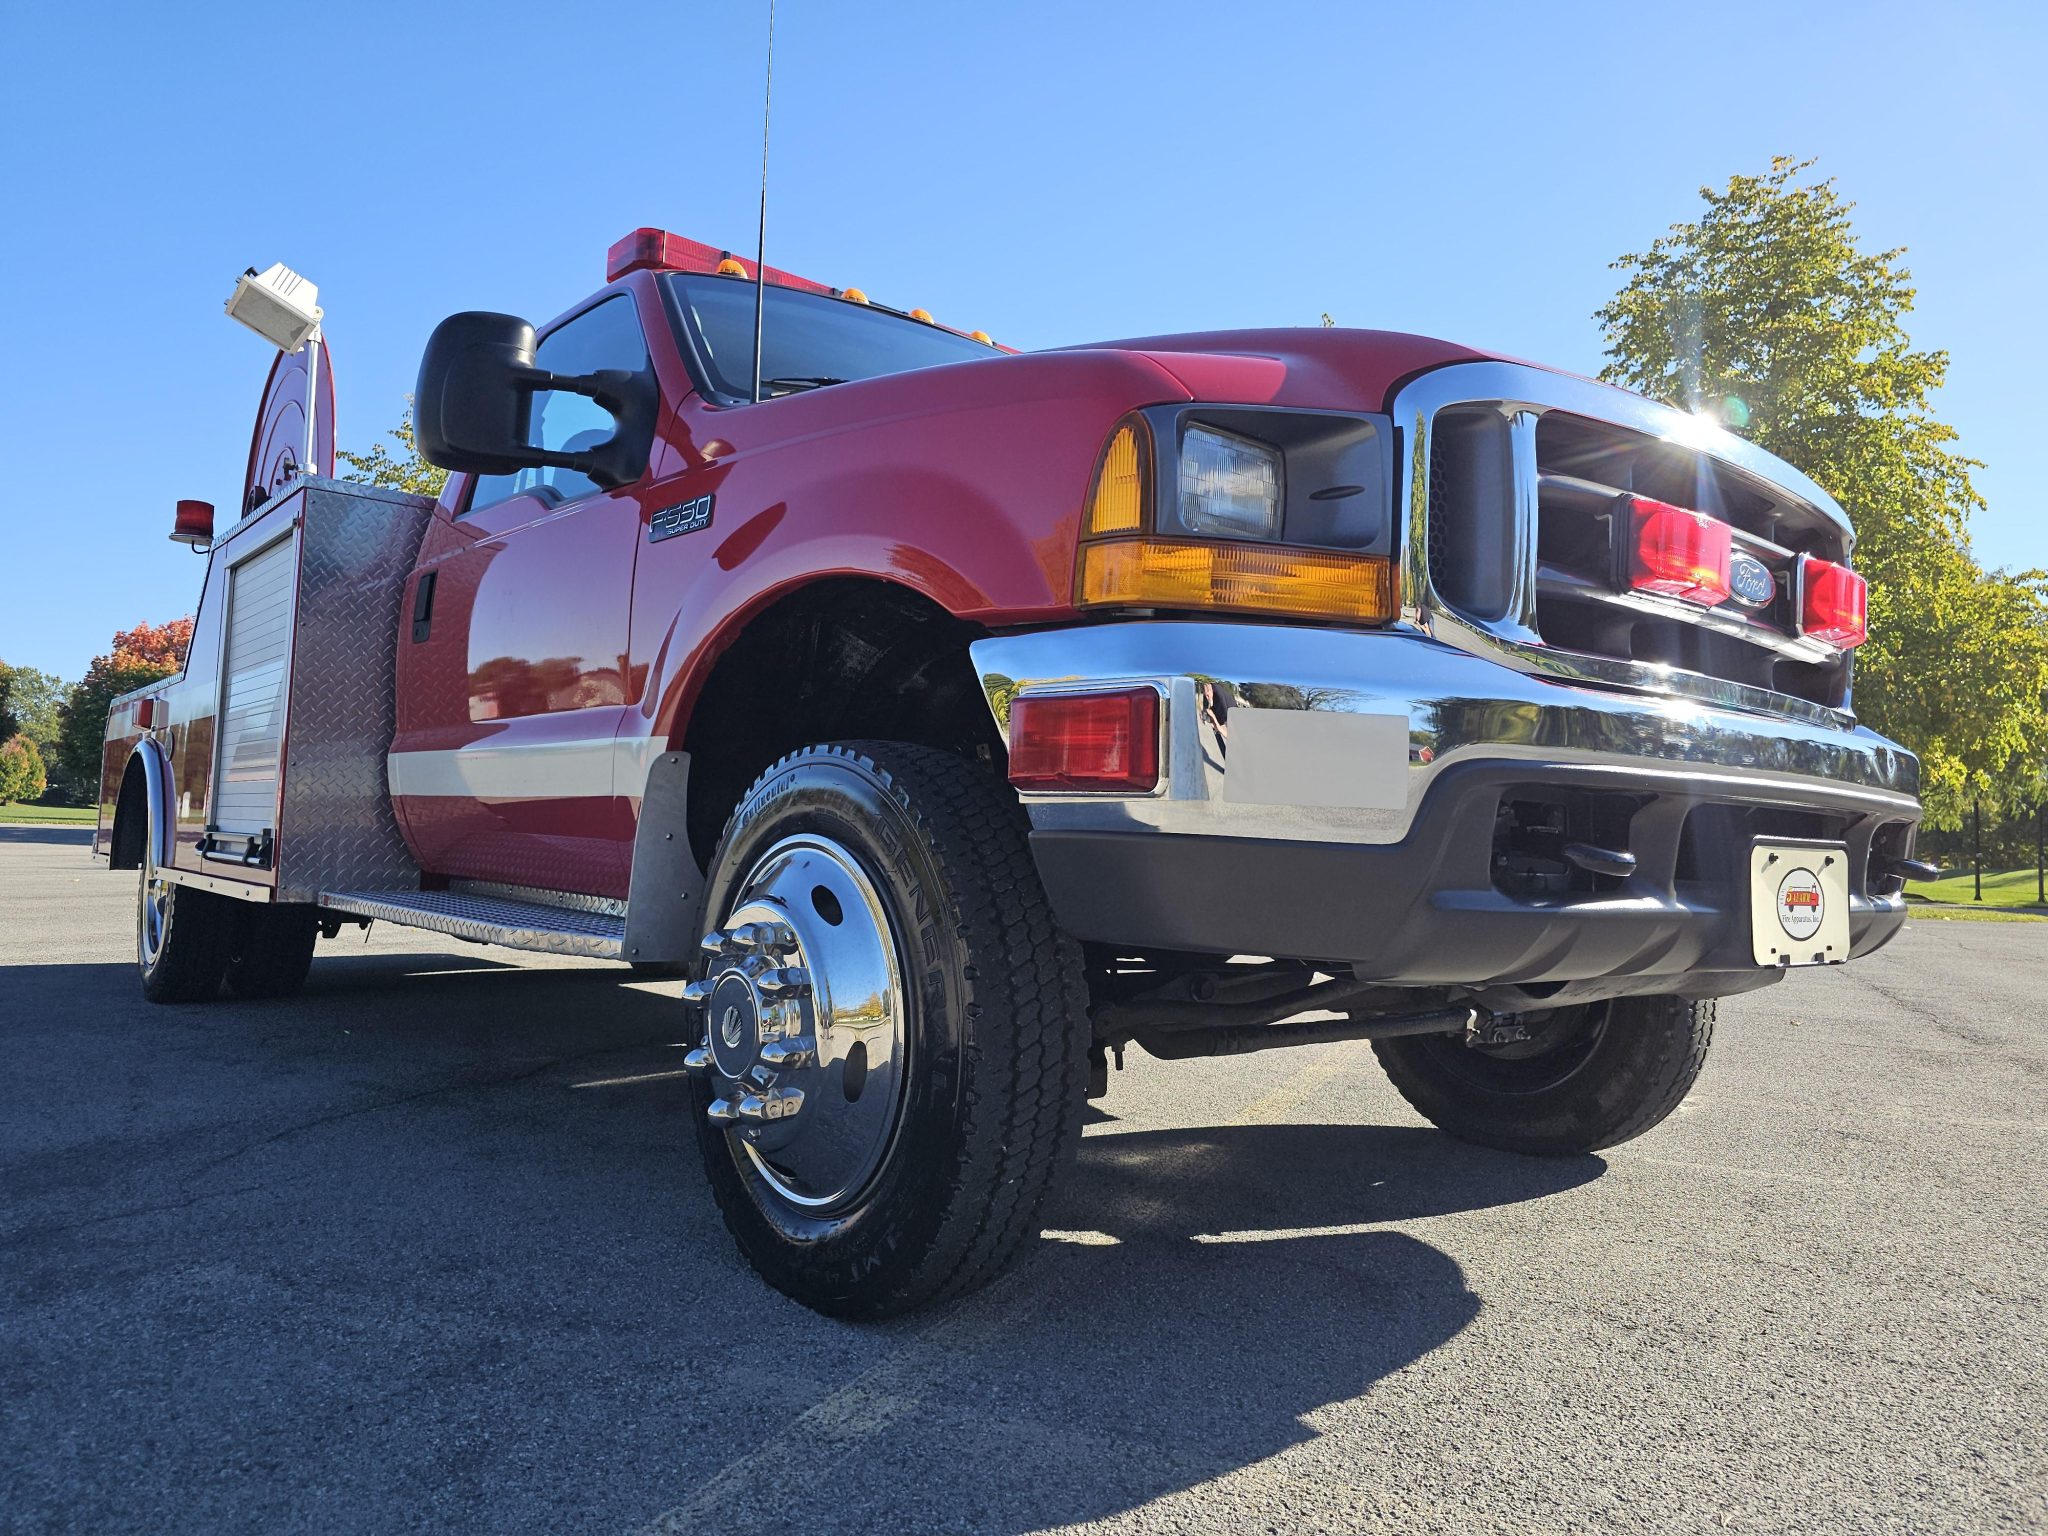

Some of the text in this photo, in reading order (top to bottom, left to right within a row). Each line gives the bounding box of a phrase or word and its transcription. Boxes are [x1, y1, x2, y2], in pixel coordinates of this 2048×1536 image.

[667, 518, 708, 535] SUPER DUTY
[1736, 563, 1766, 596] Ford
[1781, 914, 1790, 923] Fire
